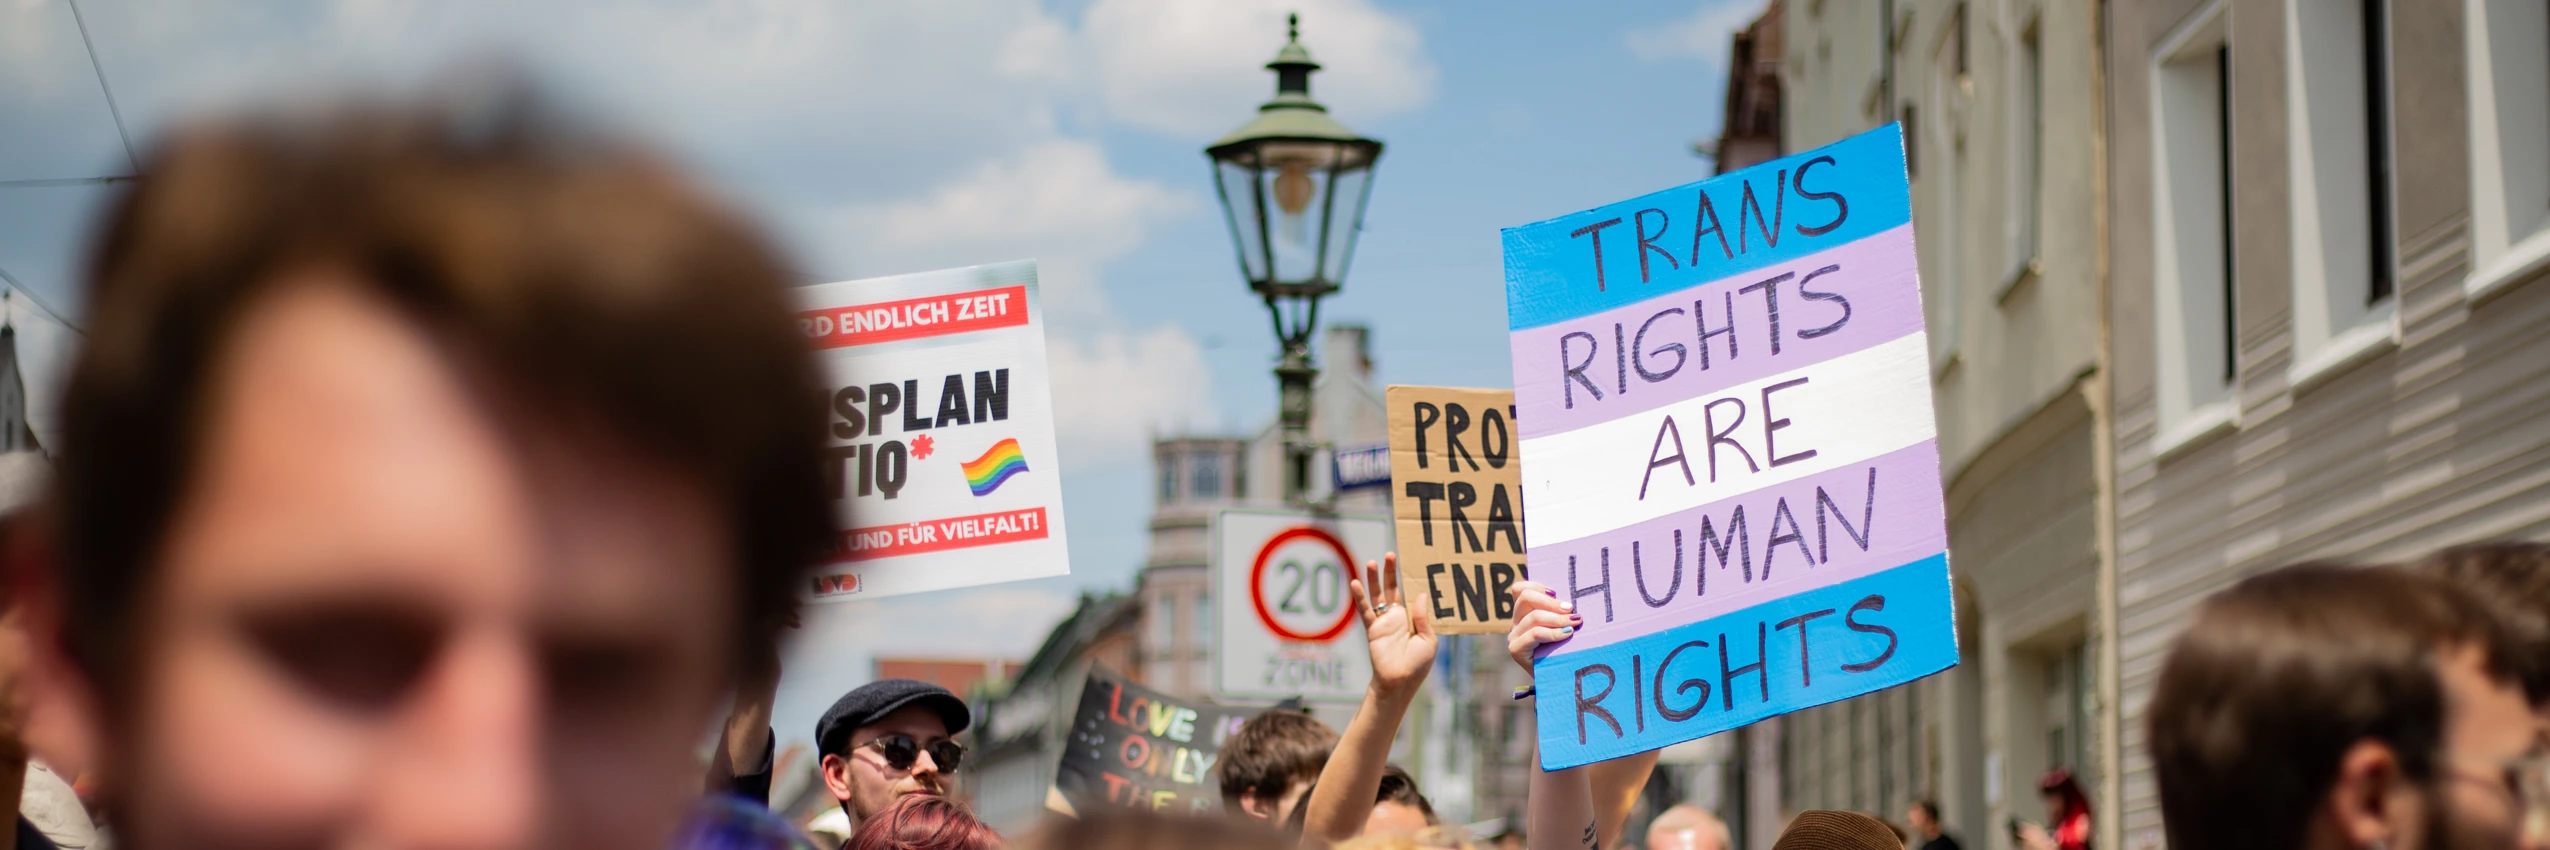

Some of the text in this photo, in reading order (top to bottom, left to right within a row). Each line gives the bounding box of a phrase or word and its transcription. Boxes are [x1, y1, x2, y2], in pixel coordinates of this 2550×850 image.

[1570, 155, 1849, 292] TRANS
[796, 293, 1010, 338] RD ENDLICH ZEIT
[1559, 264, 1851, 409] RIGHTS
[1413, 401, 1517, 473] PRO
[1638, 377, 1818, 501] ARE
[847, 530, 893, 551] UND
[898, 523, 937, 546] FÜR
[940, 511, 1040, 540] VIELFALT!
[1405, 480, 1528, 555] TRA
[1568, 467, 1877, 623] HUMAN
[1276, 560, 1341, 615] 20
[1574, 594, 1899, 745] RIGHTS
[1108, 683, 1198, 743] LOVE
[1119, 734, 1218, 785] ONLY
